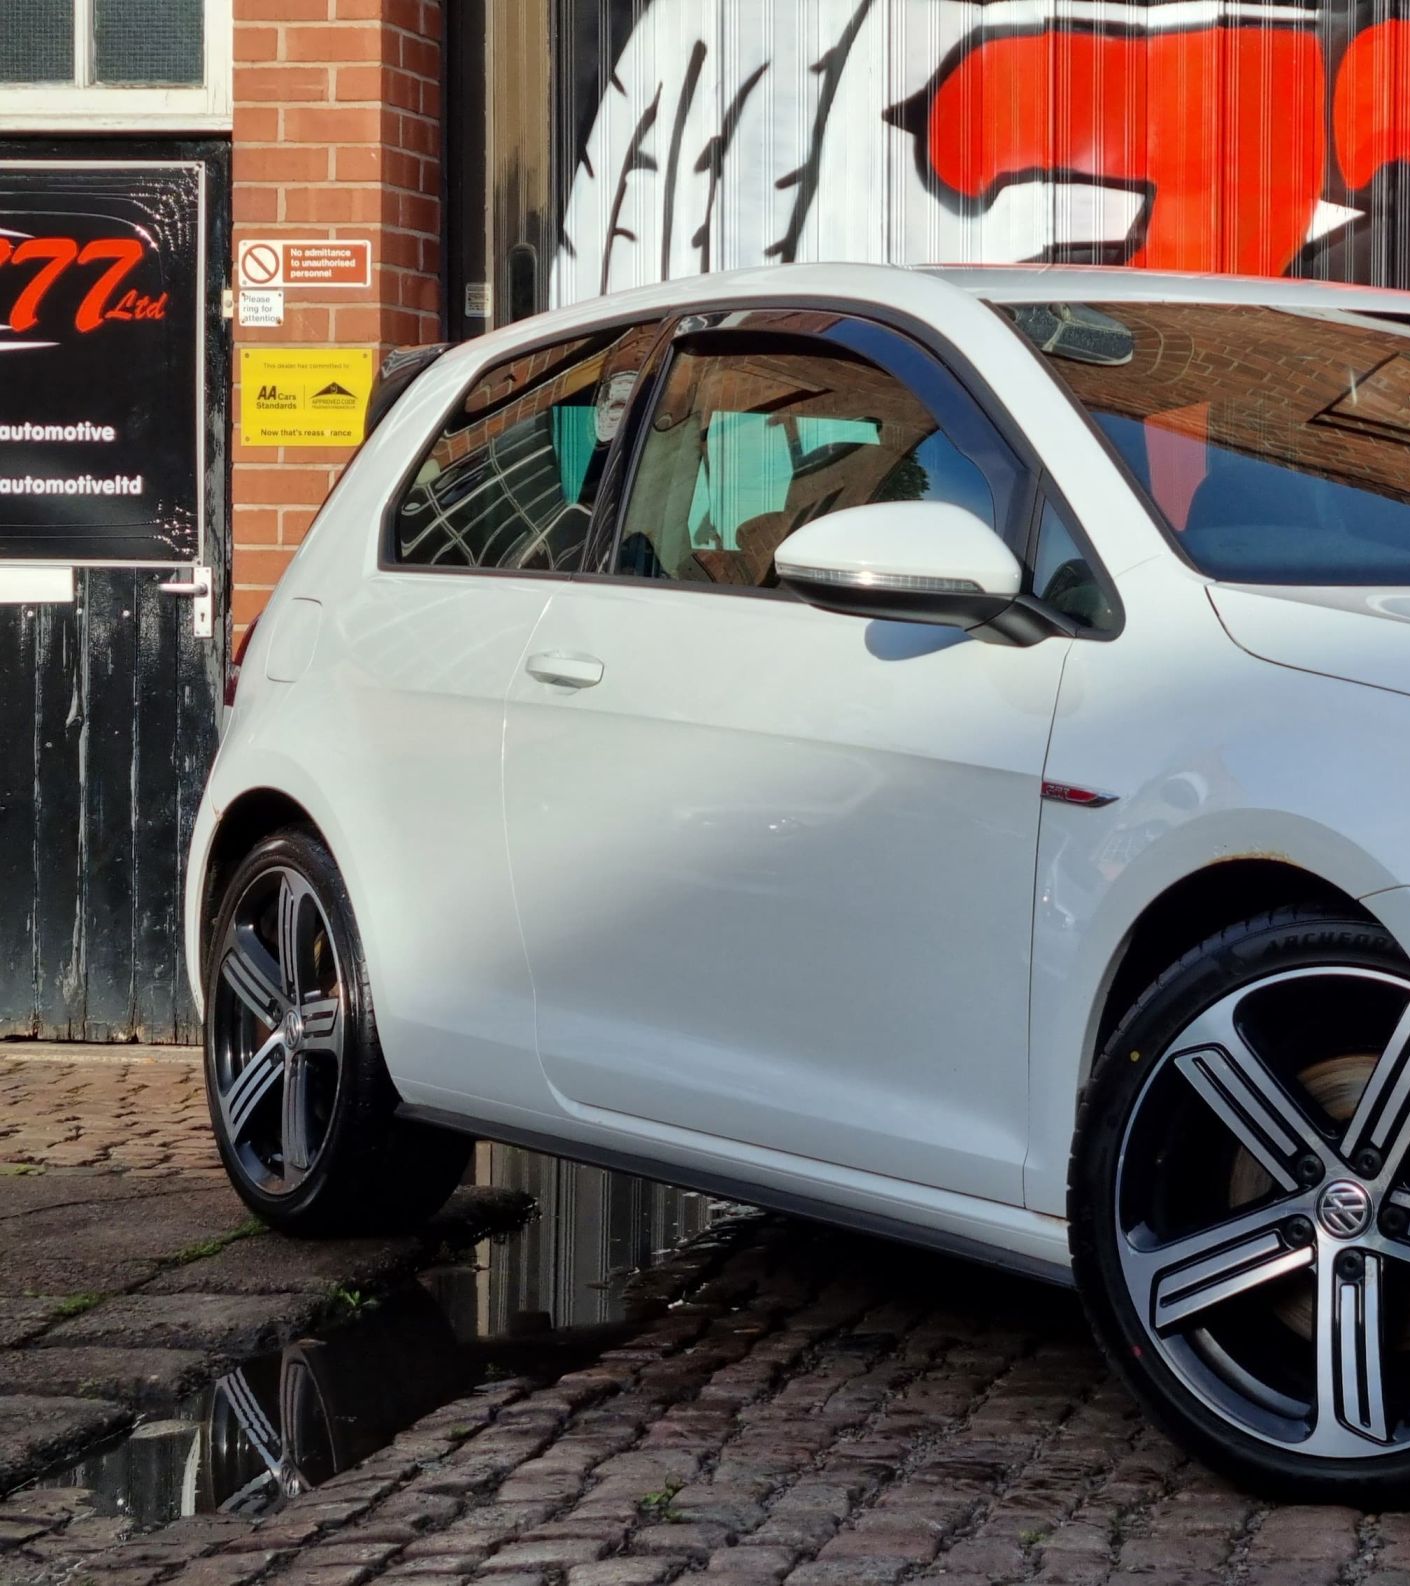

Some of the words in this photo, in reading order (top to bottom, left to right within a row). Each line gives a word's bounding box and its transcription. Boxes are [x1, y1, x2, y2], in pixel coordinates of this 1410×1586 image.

[290, 248, 303, 257] No
[304, 248, 351, 257] admittance
[290, 258, 300, 267] to
[301, 258, 356, 267] unauthorised
[290, 269, 332, 279] personnel
[0, 238, 143, 333] 77
[105, 288, 169, 320] Ltd
[243, 295, 271, 303] Please
[243, 305, 259, 314] ring
[261, 304, 272, 312] for
[257, 385, 277, 401] AA
[277, 392, 297, 401] Cars
[256, 402, 297, 410] Standards
[260, 429, 279, 437] Now
[280, 428, 303, 437] that's
